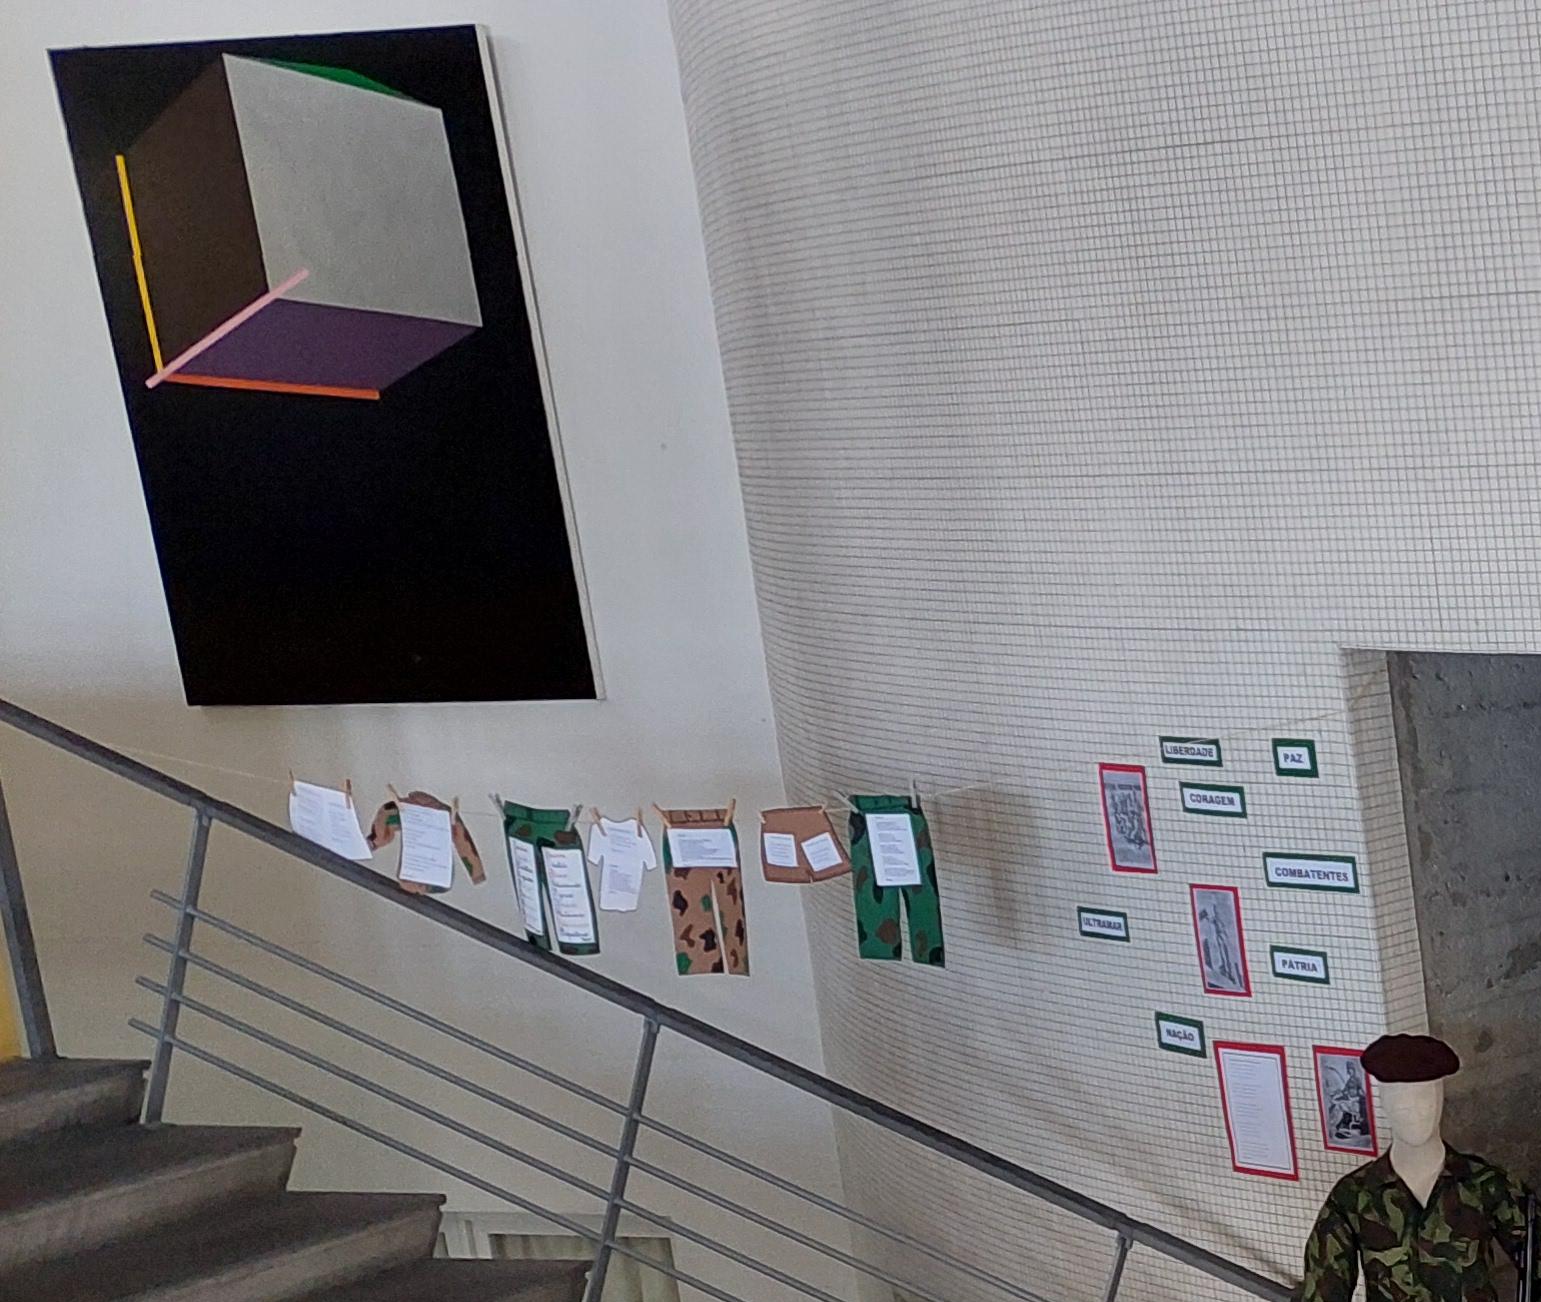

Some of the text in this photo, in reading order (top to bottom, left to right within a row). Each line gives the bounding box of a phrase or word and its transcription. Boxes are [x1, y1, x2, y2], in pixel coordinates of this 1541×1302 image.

[1165, 744, 1214, 757] LIBERDADE
[1283, 753, 1304, 764] PAZ
[1189, 793, 1235, 806] CORAGEM
[1275, 867, 1349, 882] COMBATENTES
